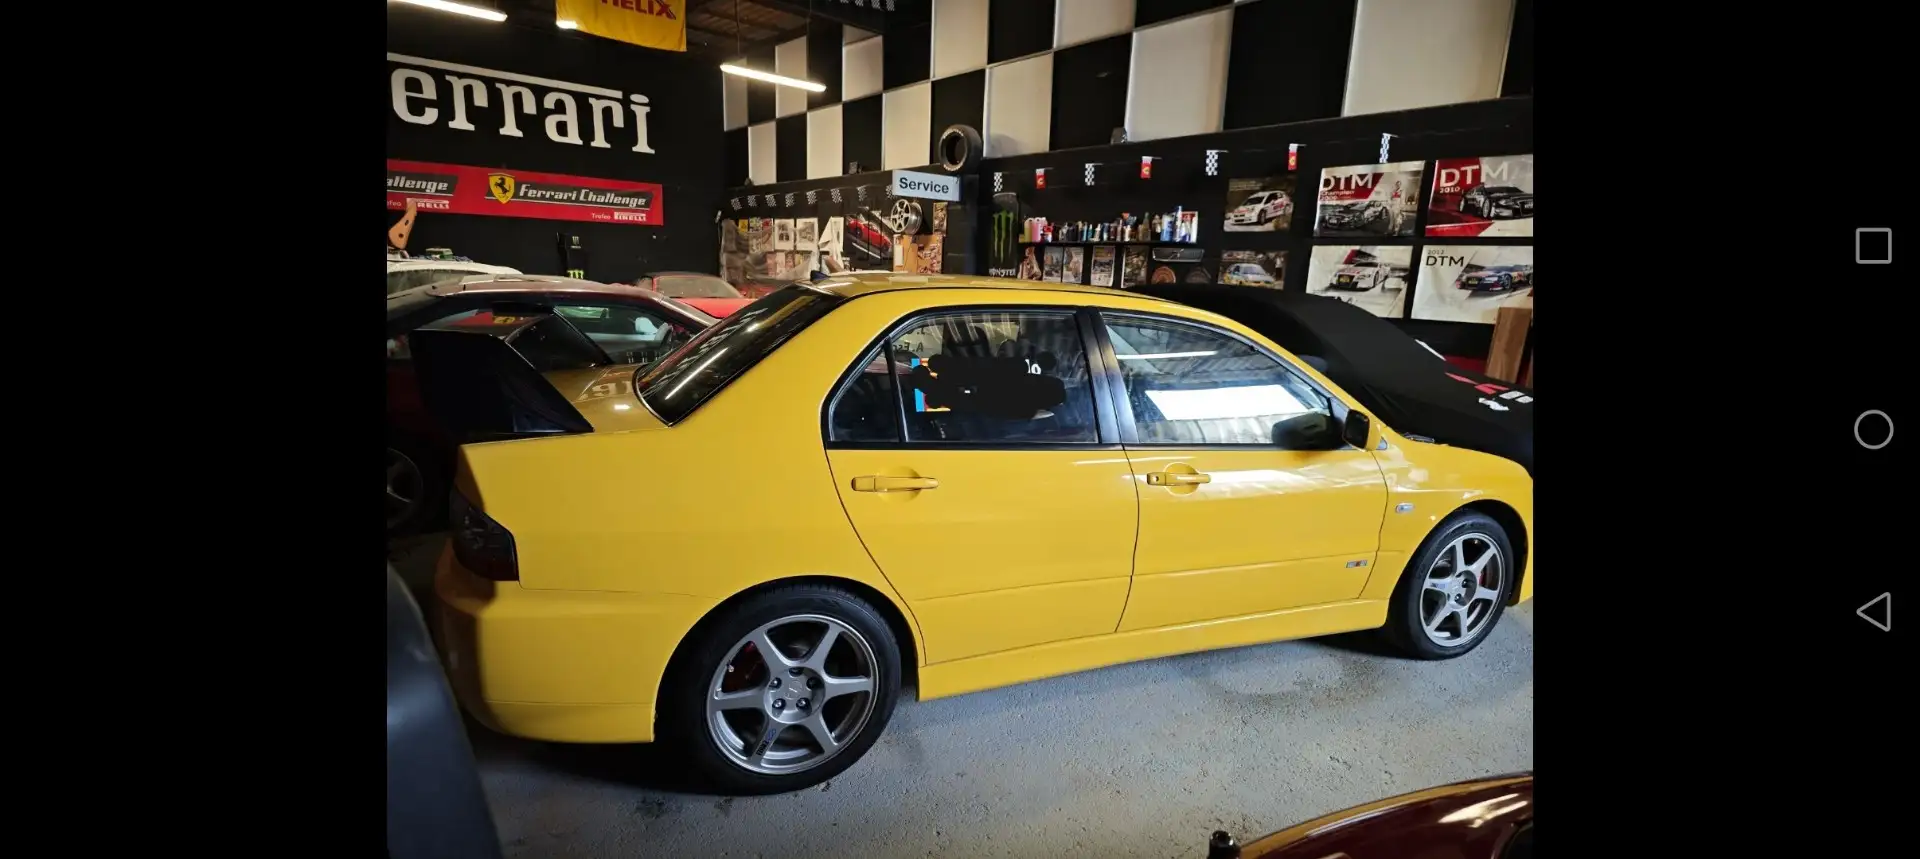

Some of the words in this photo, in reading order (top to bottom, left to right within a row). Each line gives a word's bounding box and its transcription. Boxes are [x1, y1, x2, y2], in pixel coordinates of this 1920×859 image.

[387, 53, 655, 154] errari
[1320, 173, 1373, 191] DTM
[1440, 162, 1508, 186] DTM
[899, 177, 949, 194] Service
[519, 184, 577, 201] Ferrari
[579, 189, 647, 207] Challenge
[614, 211, 647, 222] PIRELLI
[1425, 255, 1464, 267] DTM
